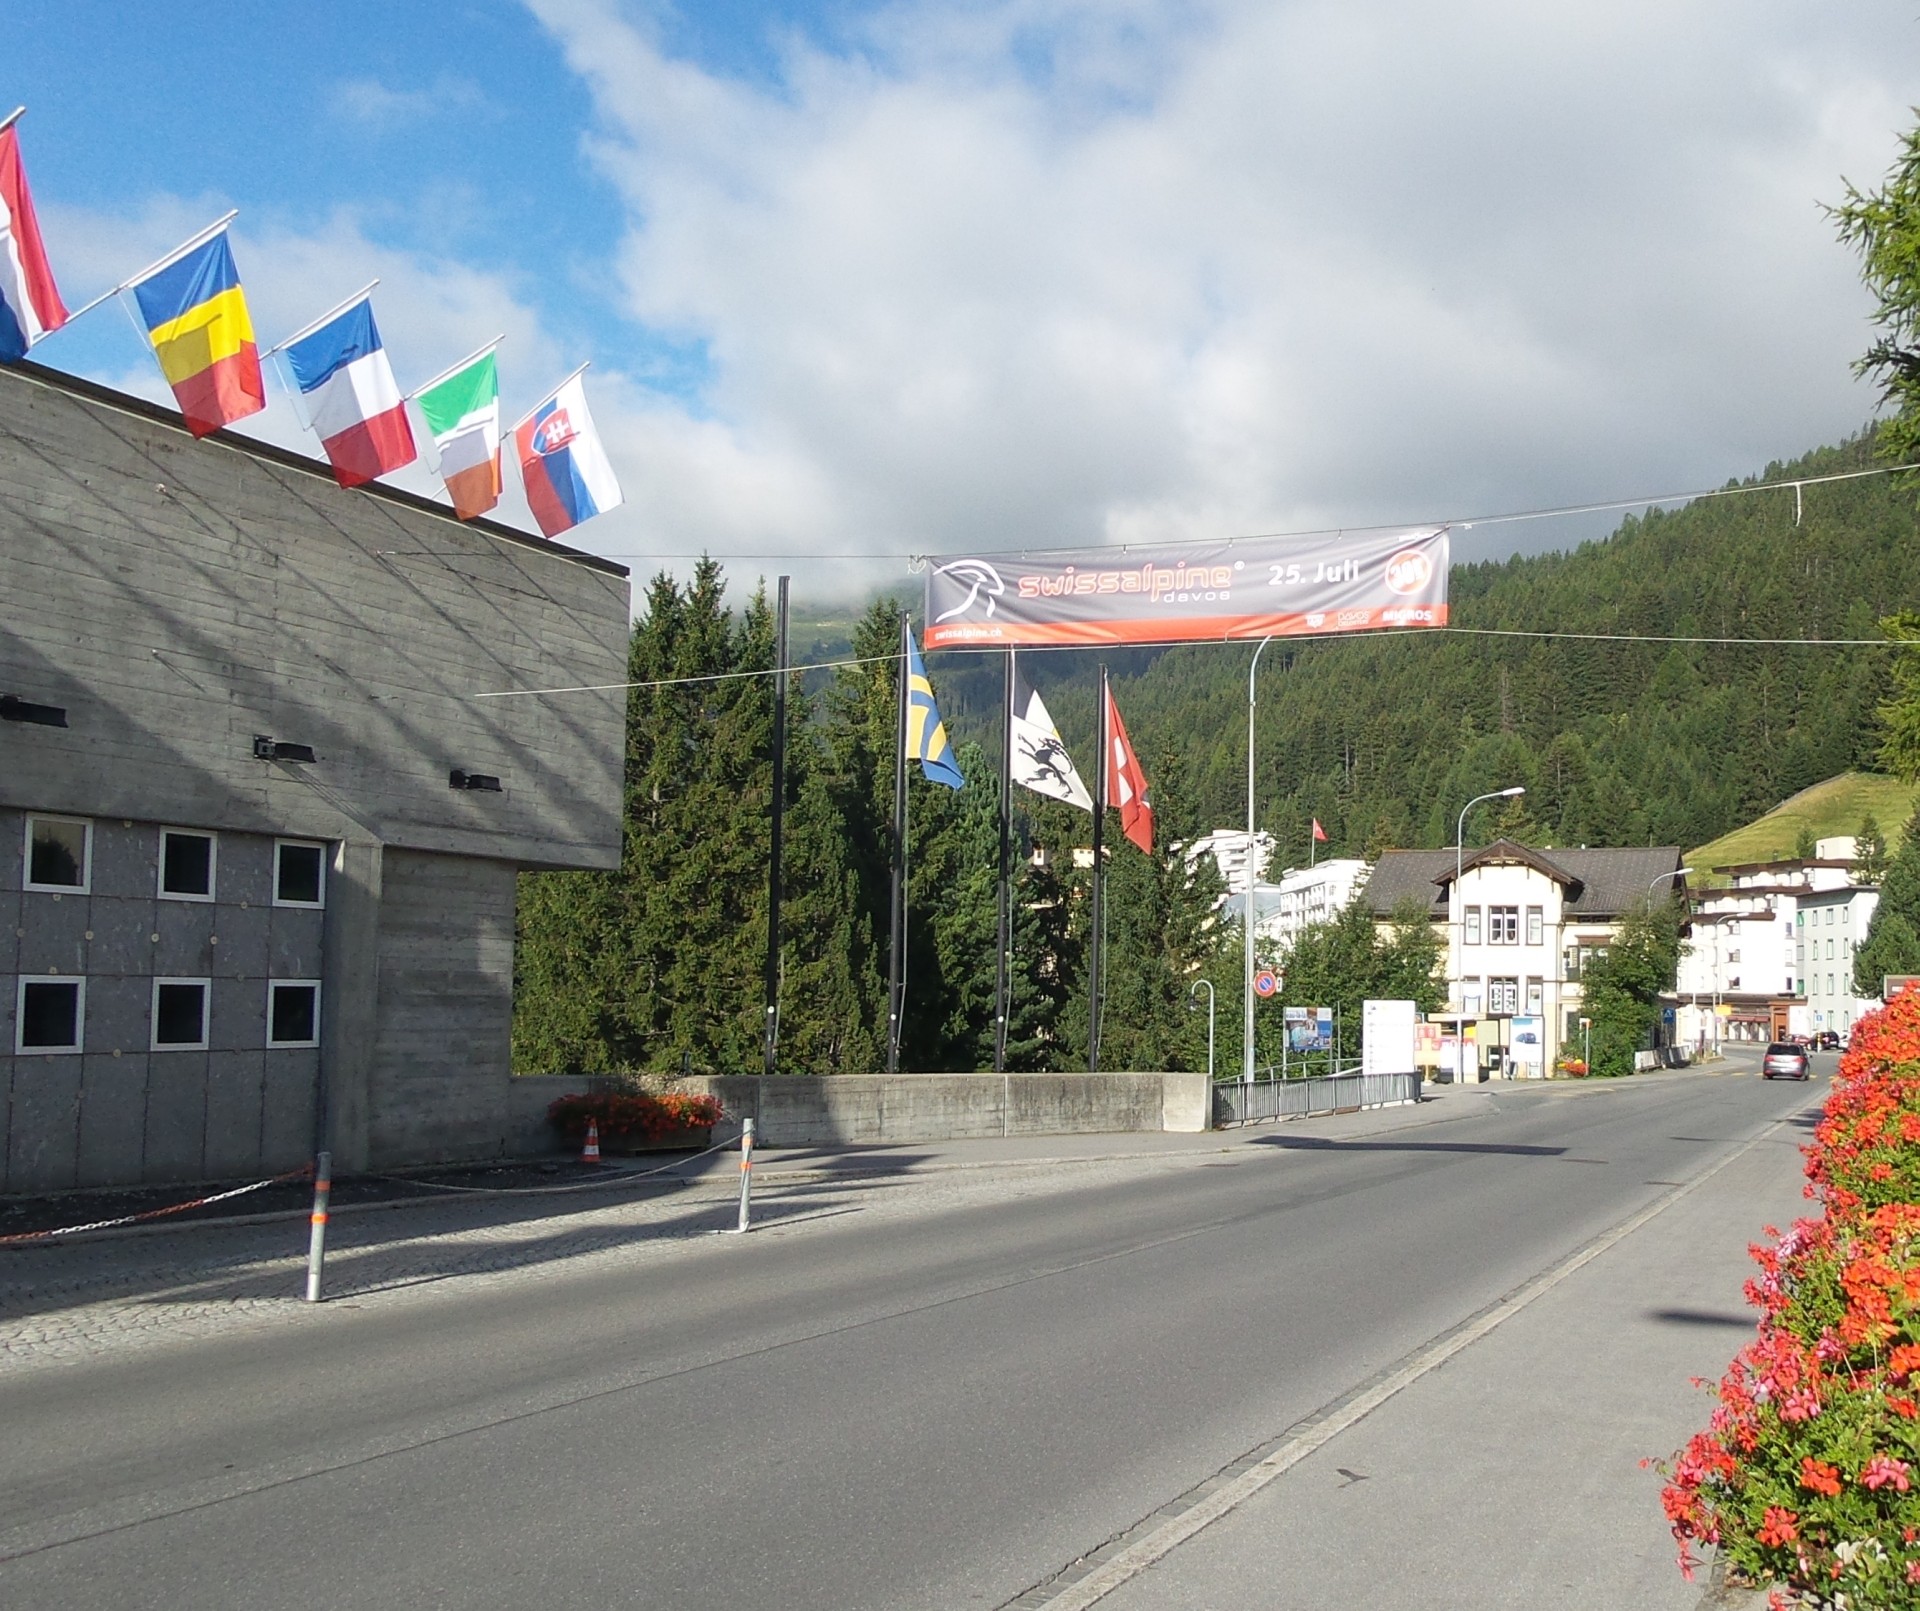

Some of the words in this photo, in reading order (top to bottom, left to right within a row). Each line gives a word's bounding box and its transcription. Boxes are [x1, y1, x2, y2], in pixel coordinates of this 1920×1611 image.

[1268, 565, 1306, 585] 25.
[1313, 559, 1360, 582] Juli
[1163, 590, 1231, 603] davos
[1337, 610, 1369, 621] DAVOS
[1382, 609, 1433, 621] MIGROS
[935, 627, 1002, 641] swissalpine.ch
